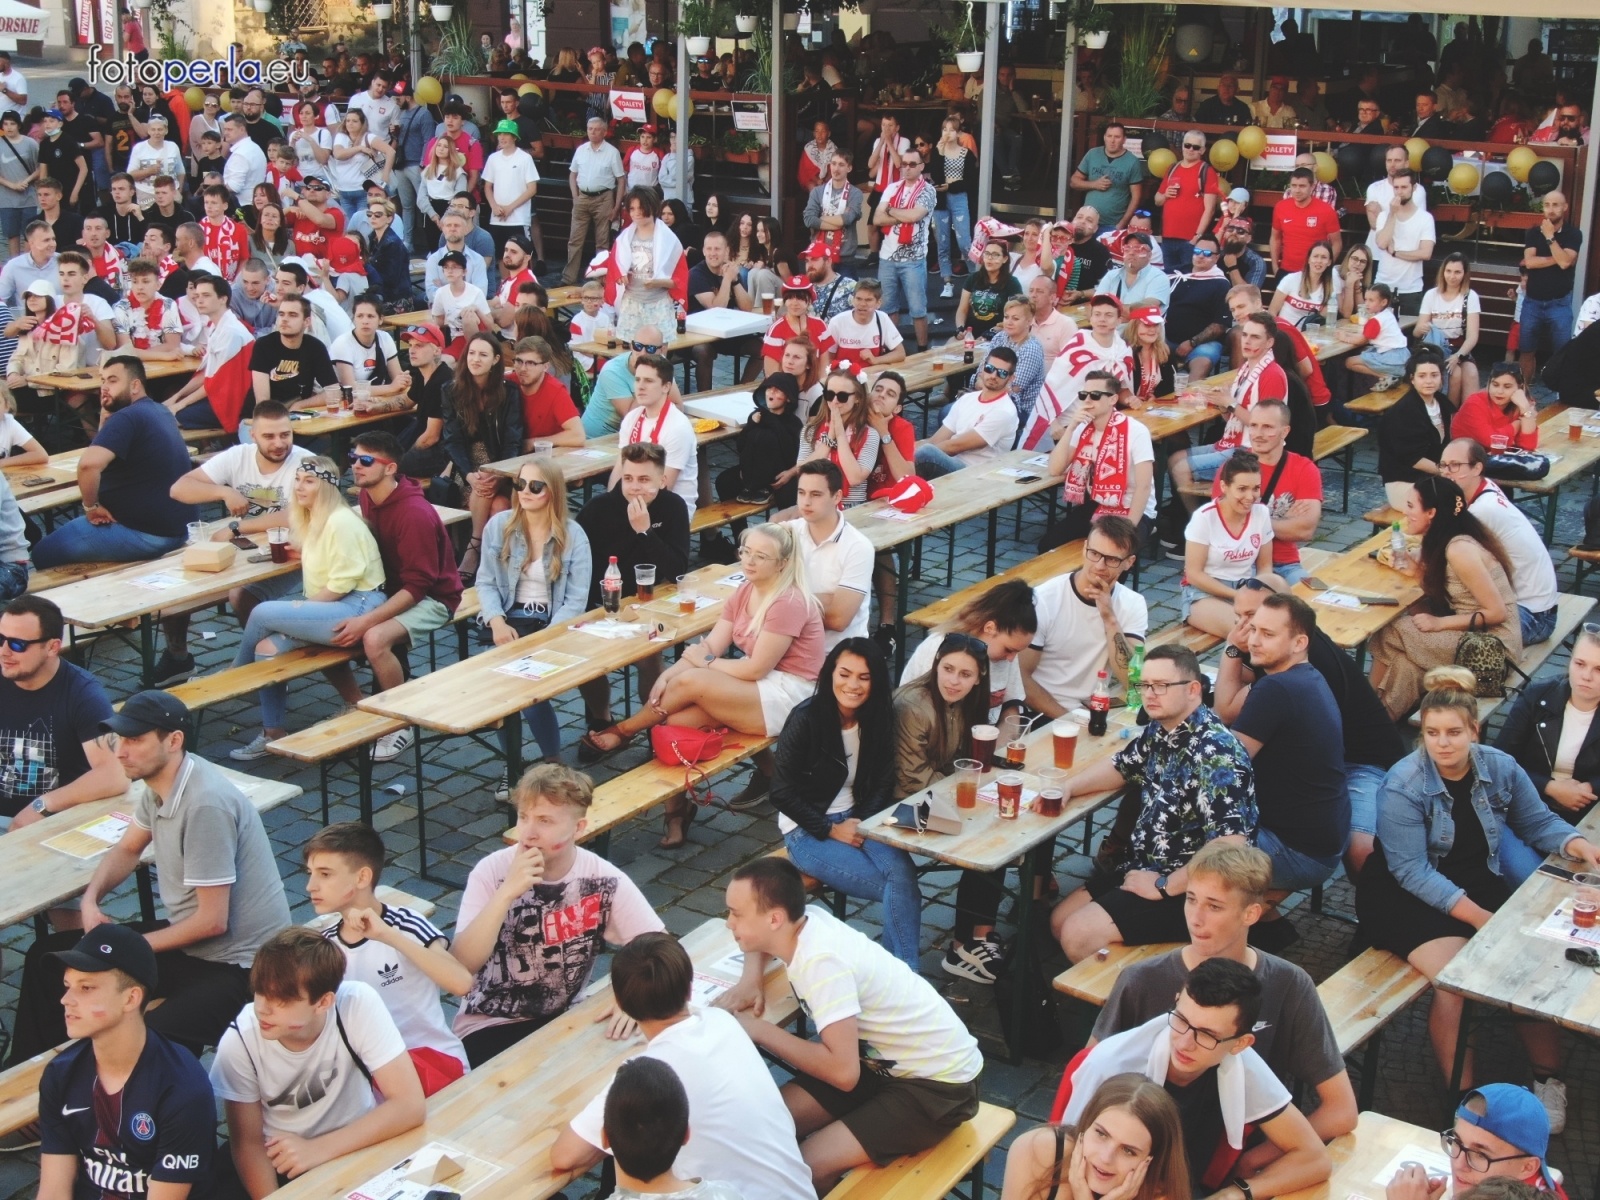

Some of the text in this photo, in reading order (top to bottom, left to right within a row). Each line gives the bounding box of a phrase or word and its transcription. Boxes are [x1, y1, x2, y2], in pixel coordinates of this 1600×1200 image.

[103, 20, 114, 40] 602
[618, 100, 643, 109] TOALETY
[1264, 146, 1293, 154] OALETY
[1290, 299, 1323, 311] POLSK
[840, 337, 861, 345] POLSKA
[1223, 547, 1255, 562] Polska
[380, 975, 404, 988] adidas
[161, 1153, 200, 1170] QNB
